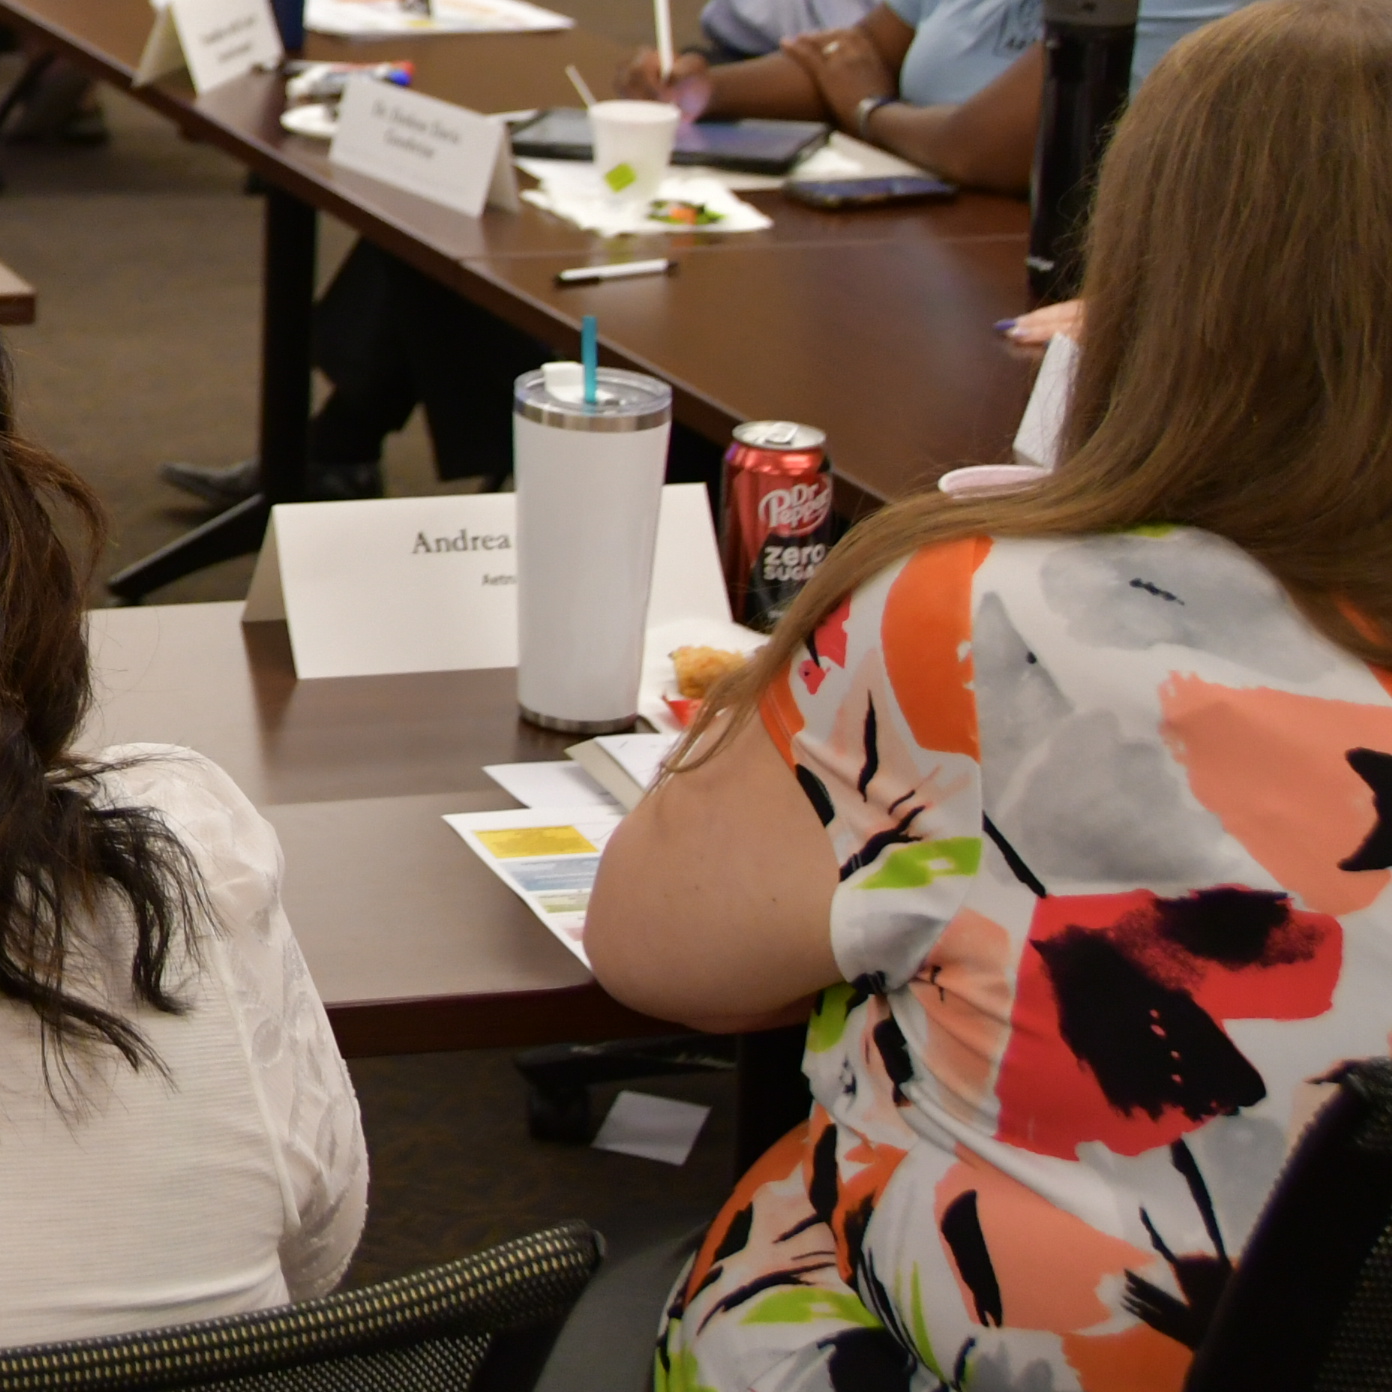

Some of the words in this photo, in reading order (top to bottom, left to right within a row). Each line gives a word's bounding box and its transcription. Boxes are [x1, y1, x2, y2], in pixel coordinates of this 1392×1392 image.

[790, 482, 820, 506] Dr
[411, 528, 512, 555] Andrea
[764, 543, 826, 566] zero
[763, 565, 817, 582] SUGA
